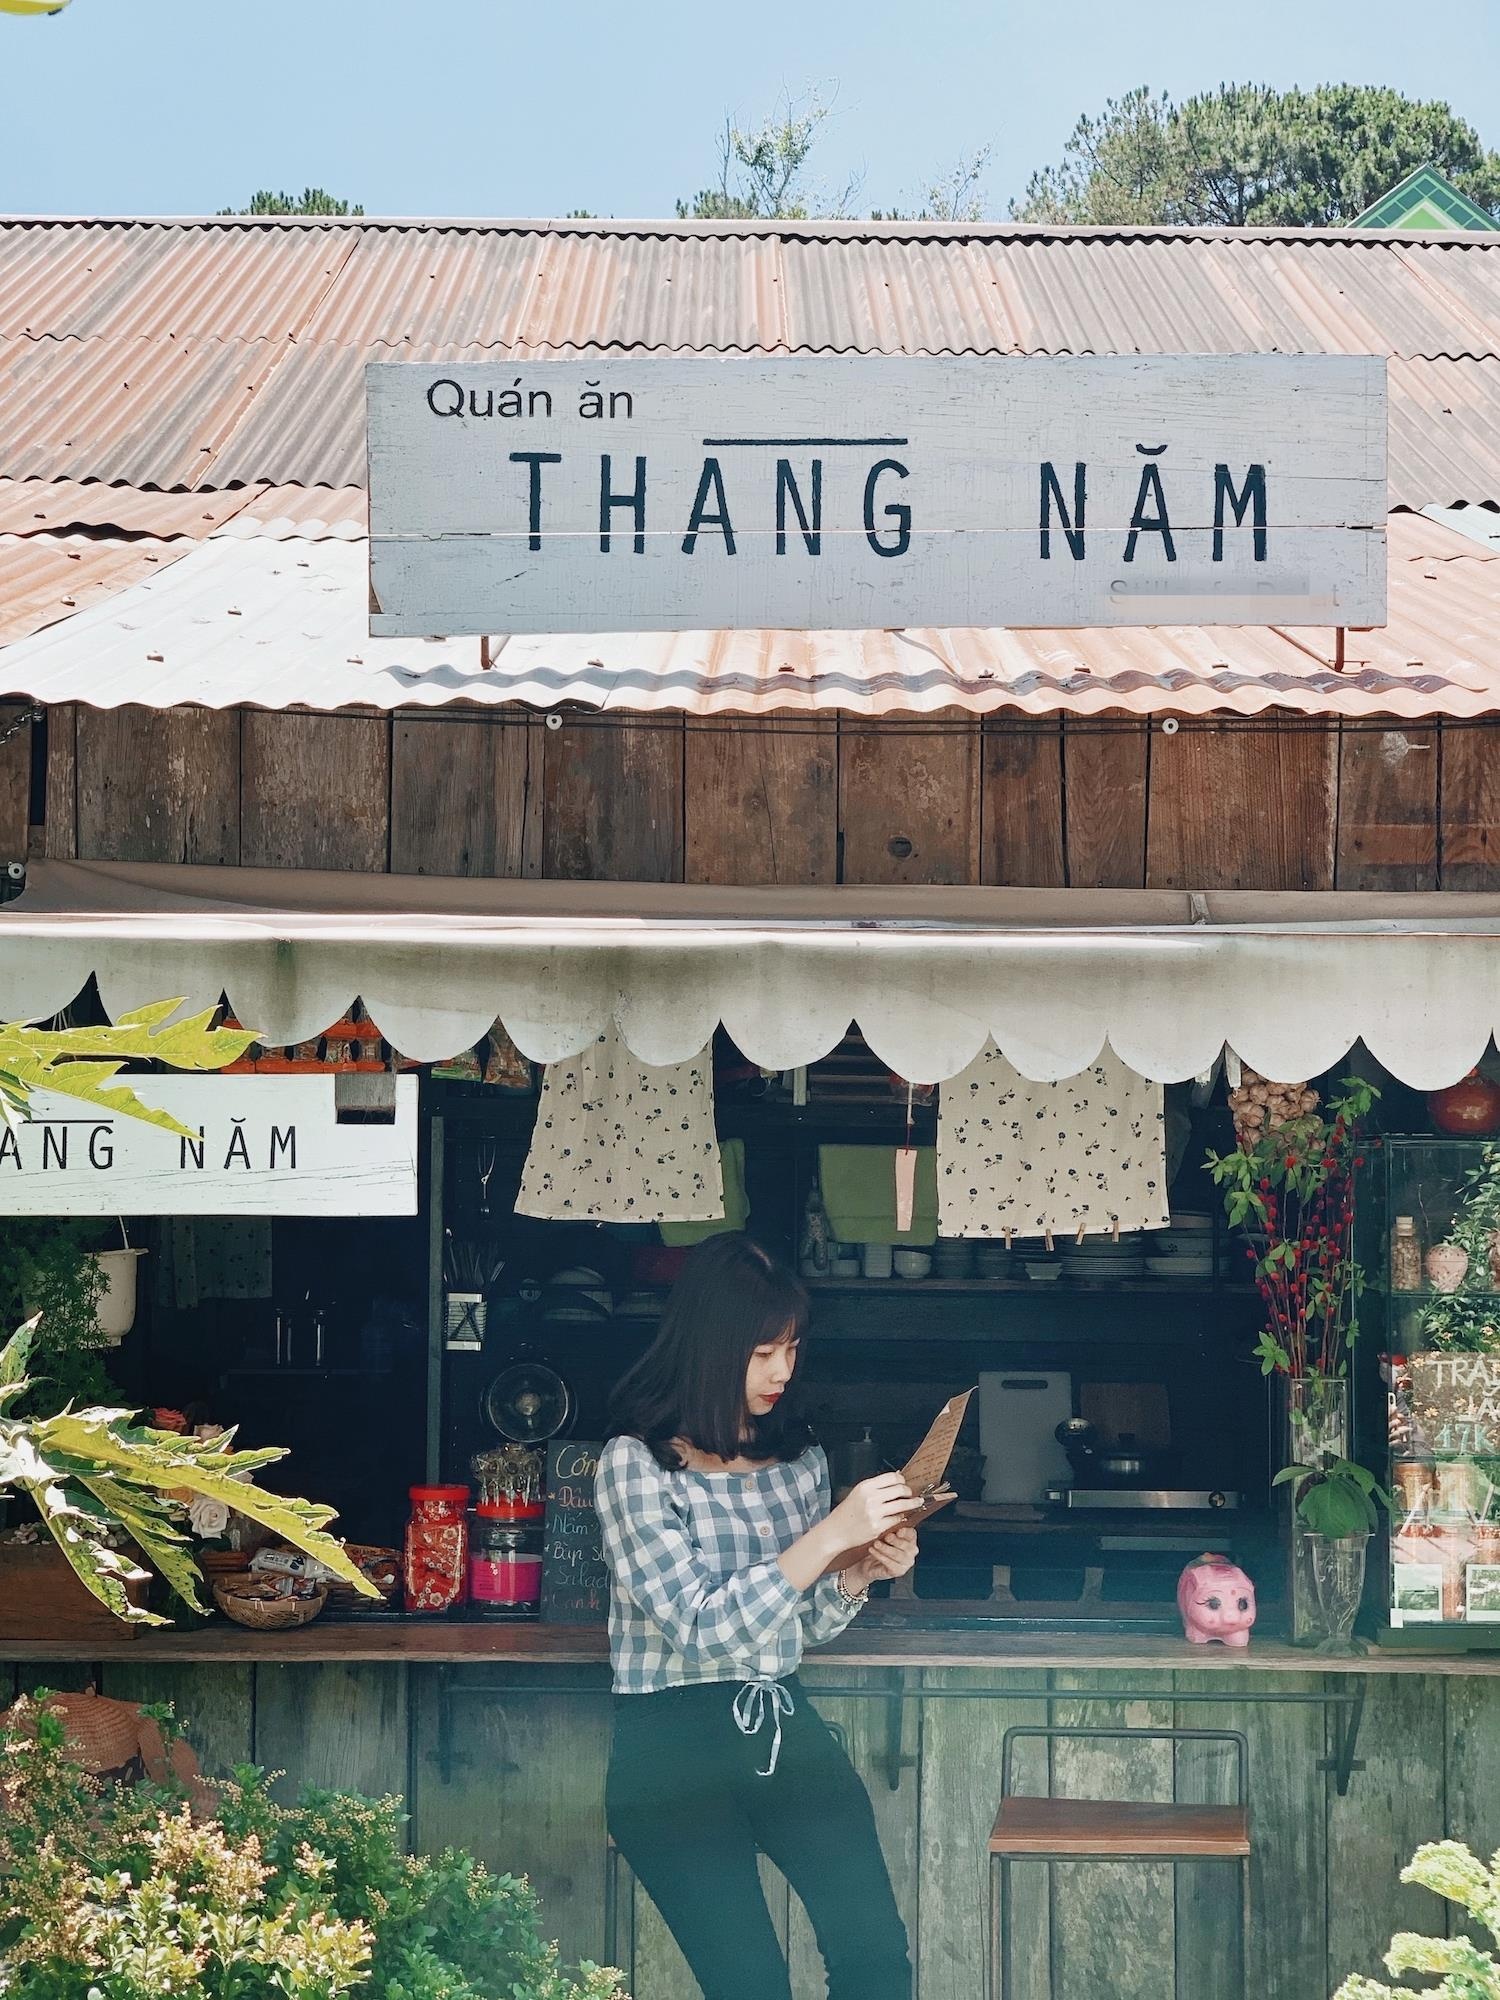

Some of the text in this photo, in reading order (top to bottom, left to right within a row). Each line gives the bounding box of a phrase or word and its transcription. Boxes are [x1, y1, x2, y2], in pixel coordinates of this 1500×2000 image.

[427, 378, 634, 419] Quán ăn
[1040, 443, 1268, 562] NĂM
[180, 1117, 297, 1169] NĂM
